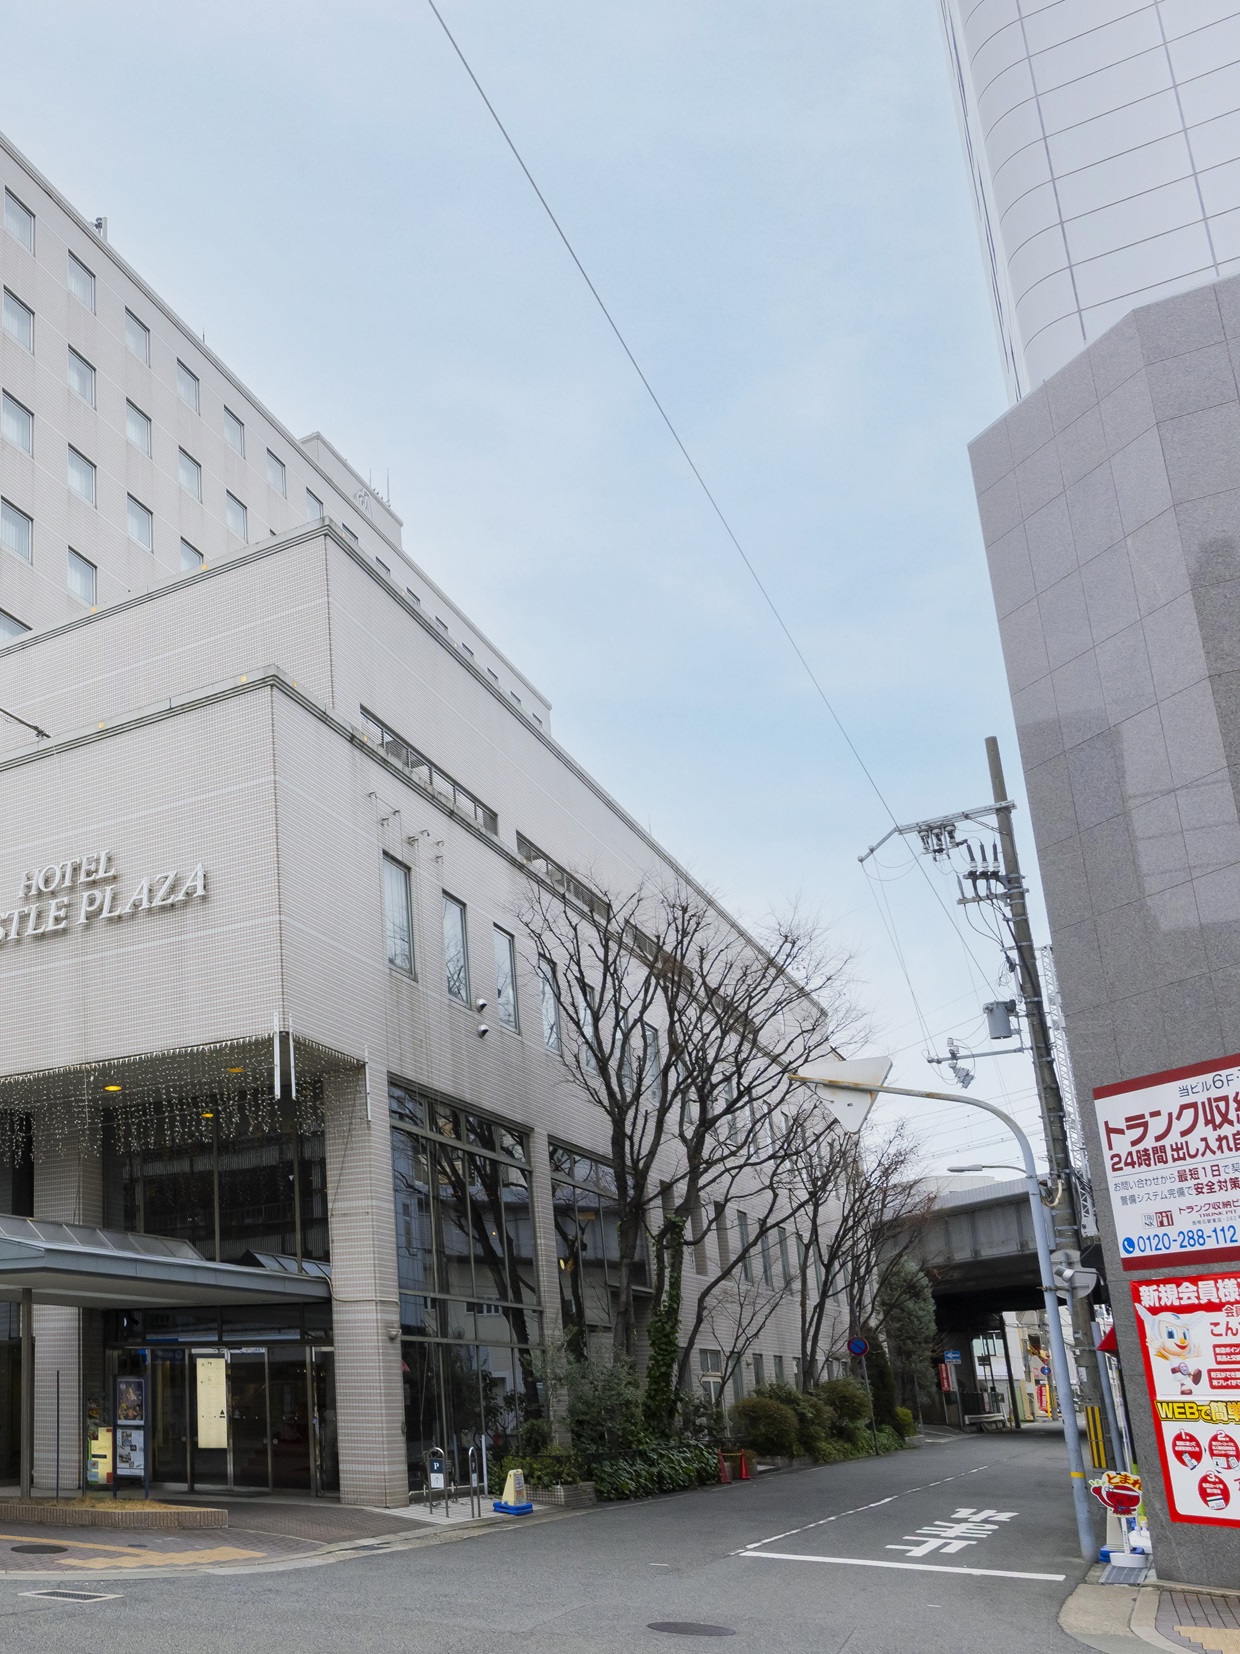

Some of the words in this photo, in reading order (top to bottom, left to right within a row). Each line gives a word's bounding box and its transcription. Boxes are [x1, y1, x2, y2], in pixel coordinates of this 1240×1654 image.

[17, 849, 117, 900] HOTEL
[76, 862, 207, 925] PLAZA
[1178, 1069, 1240, 1097] 当ビル6F・
[1137, 1225, 1238, 1252] 0120-288-112
[1139, 1278, 1240, 1308] 新規会員様
[1209, 1320, 1240, 1337] こん
[433, 1462, 440, 1470] P
[1105, 1473, 1143, 1492] とまれ
[884, 1507, 1020, 1557] 止まれ
